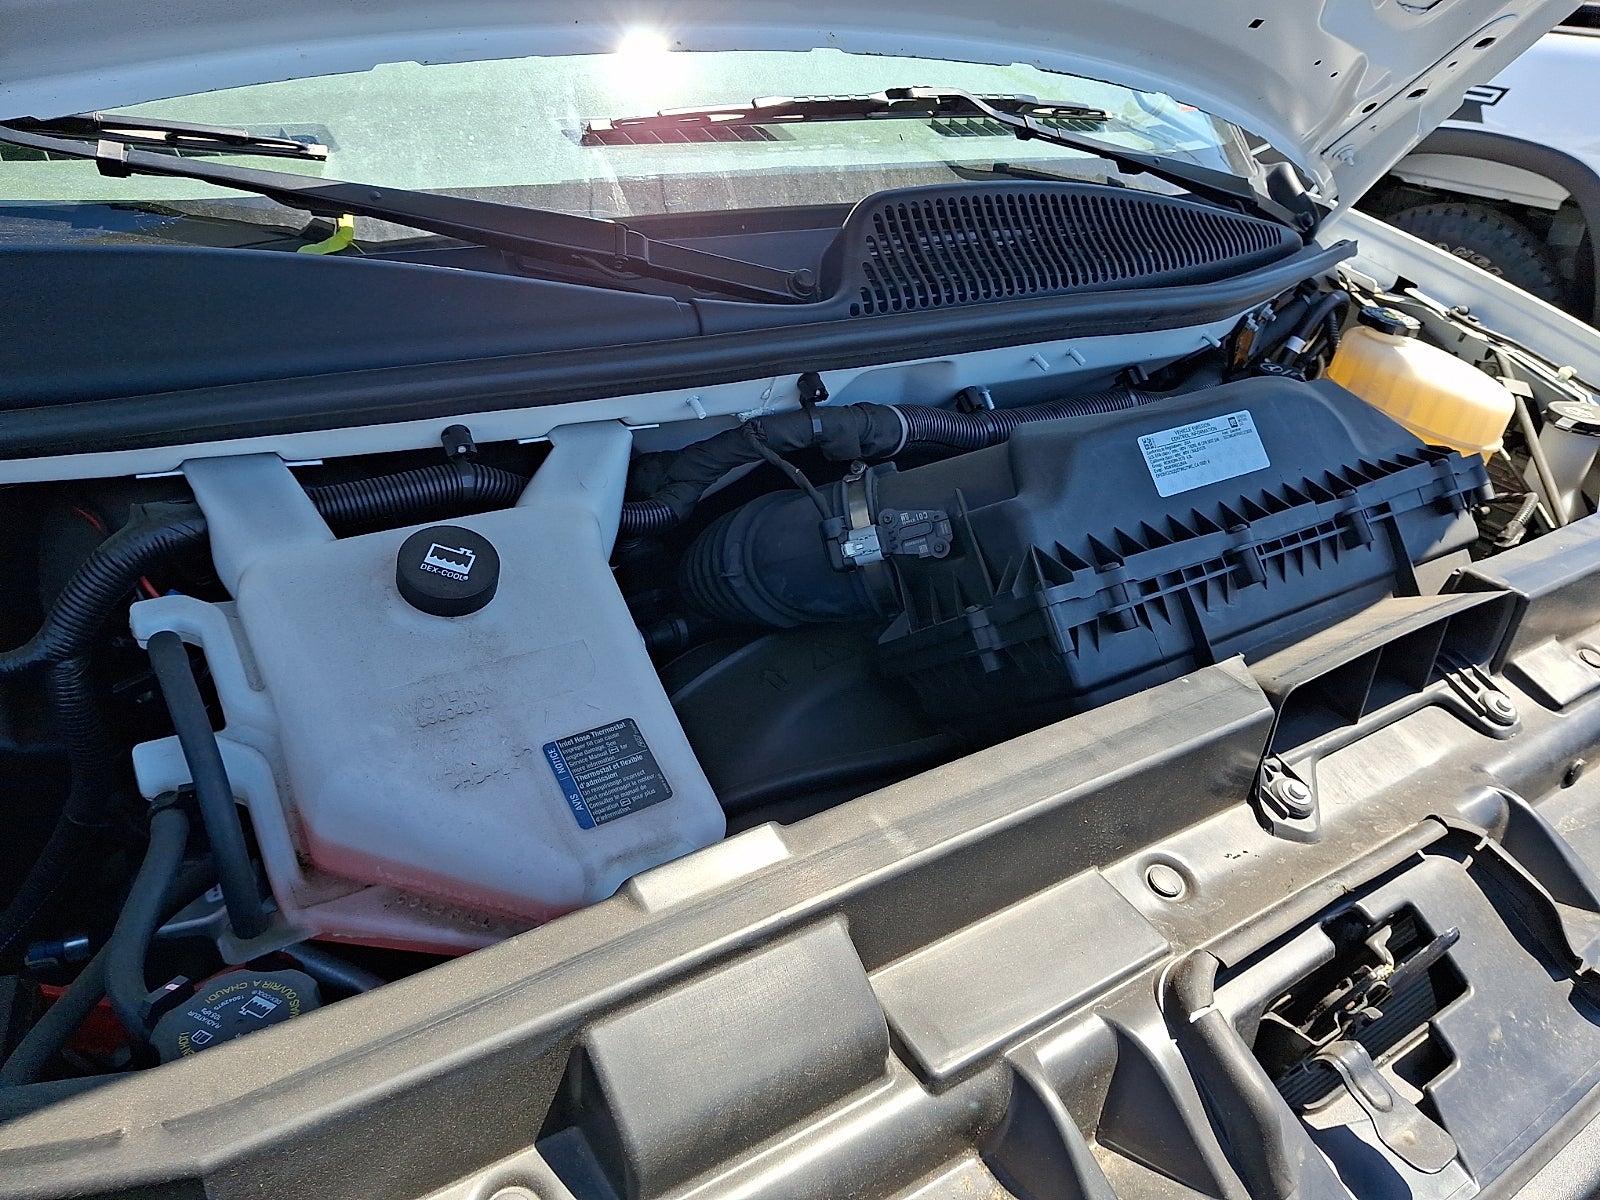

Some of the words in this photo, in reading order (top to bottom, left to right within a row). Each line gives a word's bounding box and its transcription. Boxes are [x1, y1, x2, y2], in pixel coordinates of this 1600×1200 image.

[1170, 433, 1190, 441] CONTROL
[1190, 425, 1217, 436] INFORMATION
[1174, 427, 1191, 435] VEHICLE
[574, 734, 590, 742] Hose
[591, 722, 626, 736] Thermostat
[547, 747, 566, 774] NOTICE
[566, 752, 583, 760] engine
[569, 758, 588, 766] Service
[589, 751, 608, 759] Manual
[575, 765, 612, 781] Thermostat
[620, 754, 644, 765] flexible
[579, 772, 618, 788] d'admission
[591, 779, 623, 792] remplissage
[622, 770, 646, 780] incorrect
[589, 797, 614, 808] Consulter
[620, 788, 640, 796] manuel
[598, 783, 632, 797] endommager
[569, 792, 584, 811] AVIS
[206, 981, 248, 1004] CHAUD!
[263, 981, 297, 1000] OUVRIR
[187, 1011, 222, 1029] RADIATEUR
